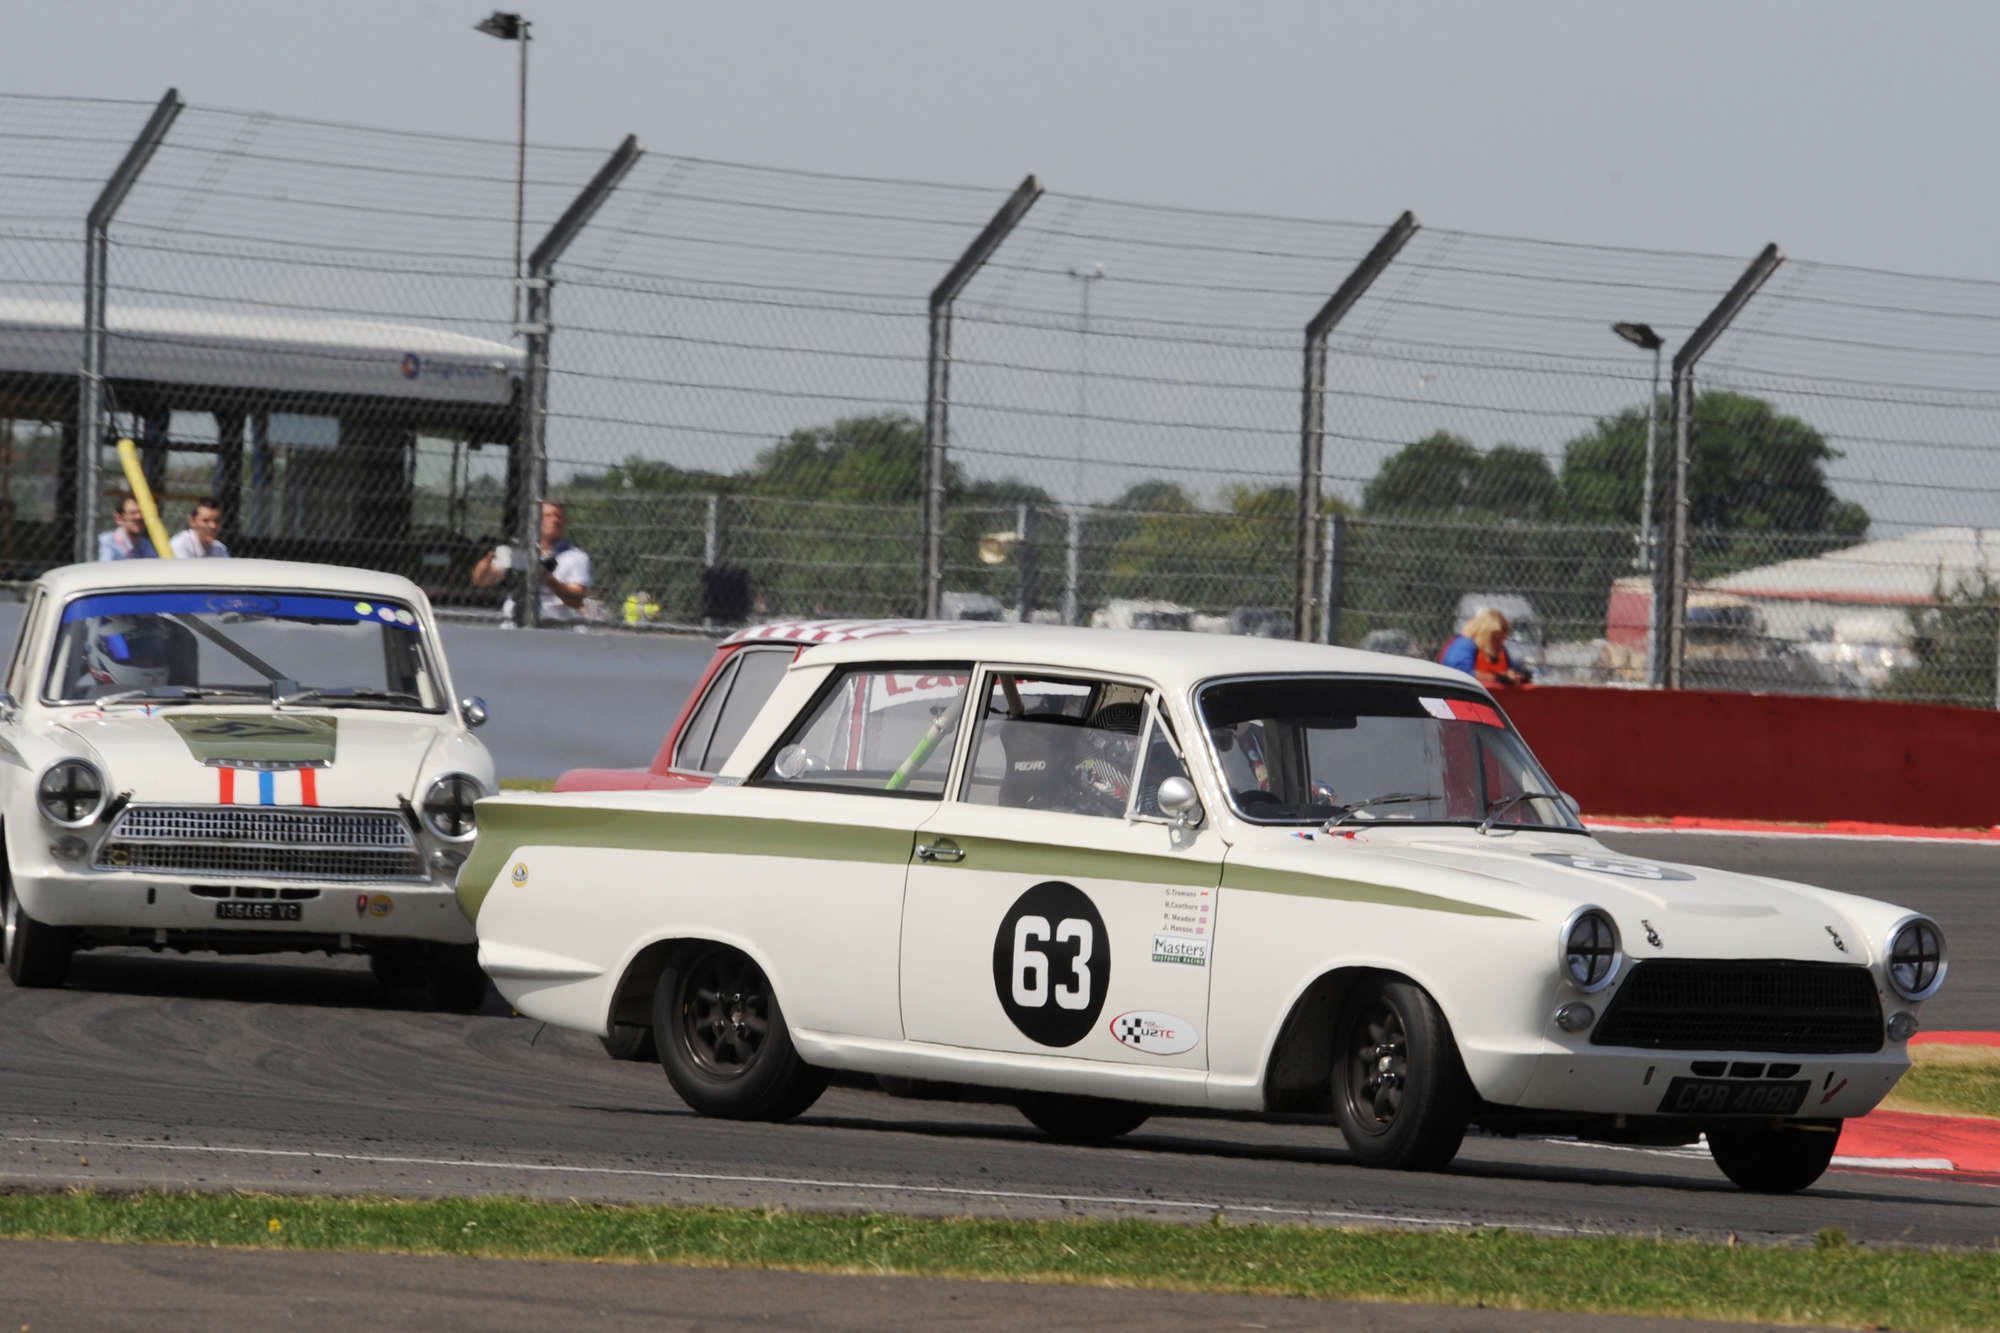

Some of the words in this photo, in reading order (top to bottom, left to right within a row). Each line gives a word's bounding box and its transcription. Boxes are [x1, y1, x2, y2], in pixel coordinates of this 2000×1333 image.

[1014, 760, 1047, 772] RECARO
[1155, 937, 1206, 958] Masters
[1012, 915, 1094, 1010] 63
[1141, 1028, 1177, 1040] U2TC
